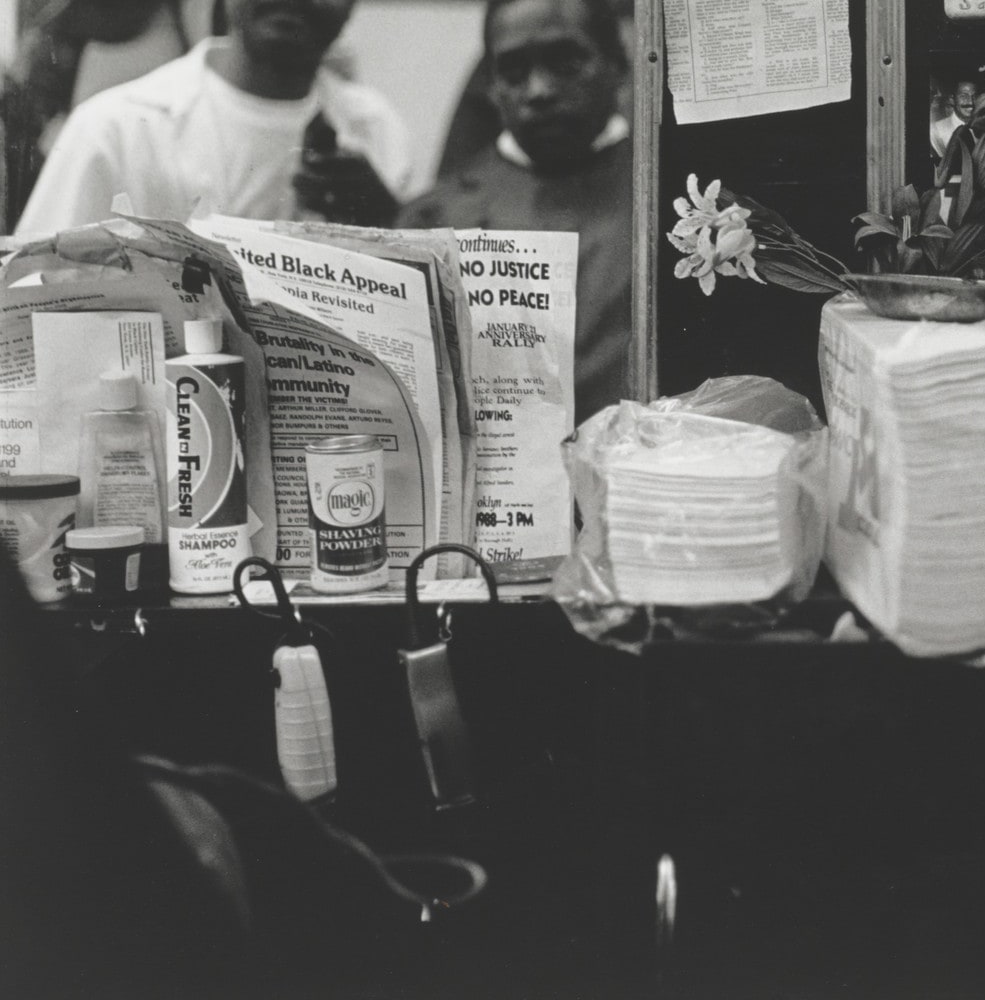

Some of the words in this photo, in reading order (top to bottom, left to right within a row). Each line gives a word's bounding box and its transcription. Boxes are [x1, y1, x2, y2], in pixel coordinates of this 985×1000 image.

[457, 233, 537, 253] ontinues...
[236, 248, 276, 269] ited
[281, 254, 337, 282] Black
[341, 268, 408, 300] Appeal
[459, 260, 485, 278] NO
[489, 260, 550, 280] JUSTICE
[311, 290, 375, 315] Revisited
[468, 289, 494, 306] NO
[499, 289, 550, 310] PEACE!
[487, 322, 528, 332] JANUARY
[478, 330, 547, 343] ANNIVERSARY
[492, 339, 536, 348] RALLY
[254, 329, 325, 356] Brutality
[328, 344, 346, 358] in
[349, 351, 376, 367] the
[266, 354, 355, 376] can/Latino
[493, 375, 518, 386] along
[523, 377, 544, 385] with
[492, 386, 534, 395] continue
[176, 376, 200, 440] CLEAN
[496, 396, 521, 406] Daily
[474, 410, 512, 421] LOWING:
[0, 419, 33, 430] tution
[178, 455, 200, 518] FRESH
[331, 490, 371, 517] magic
[477, 496, 502, 512] oklyn
[516, 511, 534, 527] PM
[319, 525, 382, 540] SHAVING
[179, 537, 237, 550] SHAMPOO
[320, 537, 382, 551] POWDER
